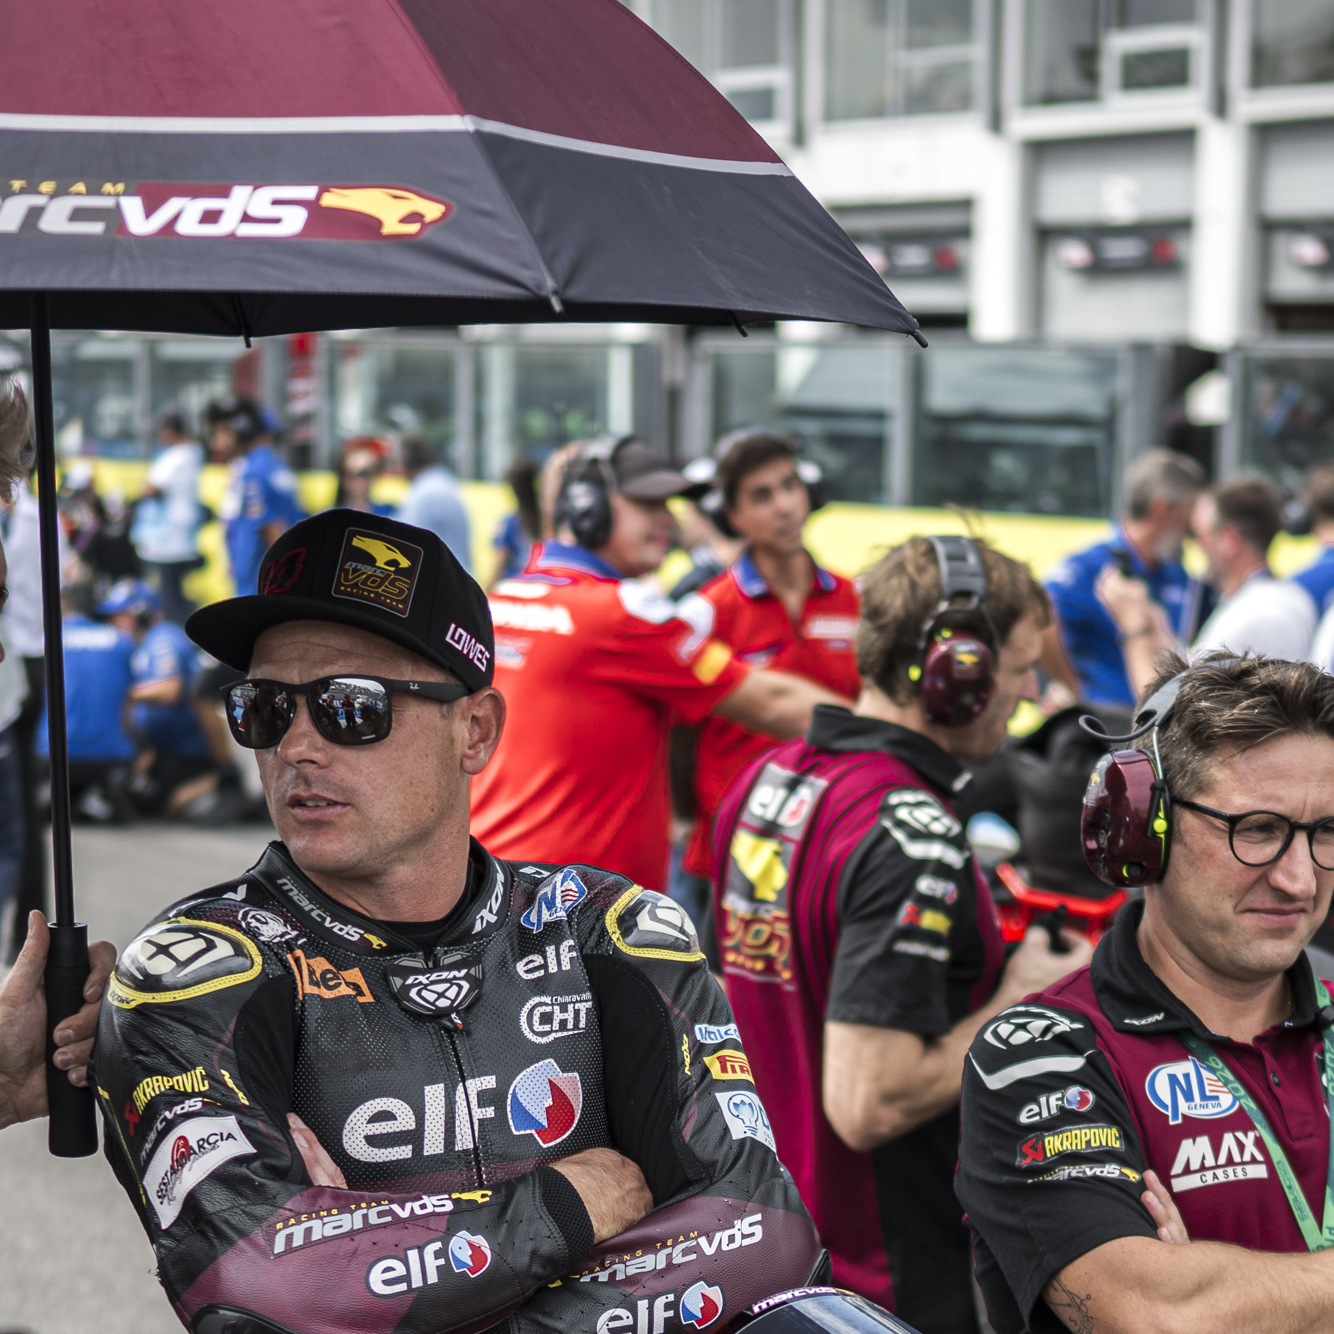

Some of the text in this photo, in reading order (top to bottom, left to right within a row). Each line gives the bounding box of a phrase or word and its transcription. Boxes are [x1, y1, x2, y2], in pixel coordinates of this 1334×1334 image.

[9, 179, 126, 196] TEAM
[340, 586, 404, 609] RACING TEAM
[445, 622, 491, 673] LOWES
[516, 940, 577, 980] elf
[405, 968, 468, 985] IXON
[532, 1000, 593, 1032] CHT
[716, 1054, 752, 1077] PIR
[1207, 1054, 1257, 1112] 2026
[342, 1075, 497, 1163] elf
[1019, 1092, 1063, 1124] elf
[1187, 1101, 1223, 1111] GENEVA
[1170, 1131, 1264, 1175] MAX
[1200, 1166, 1249, 1184] CASES
[275, 1200, 390, 1230] RACING TEAM
[656, 1230, 698, 1249] TEAM
[368, 1241, 446, 1296] elf
